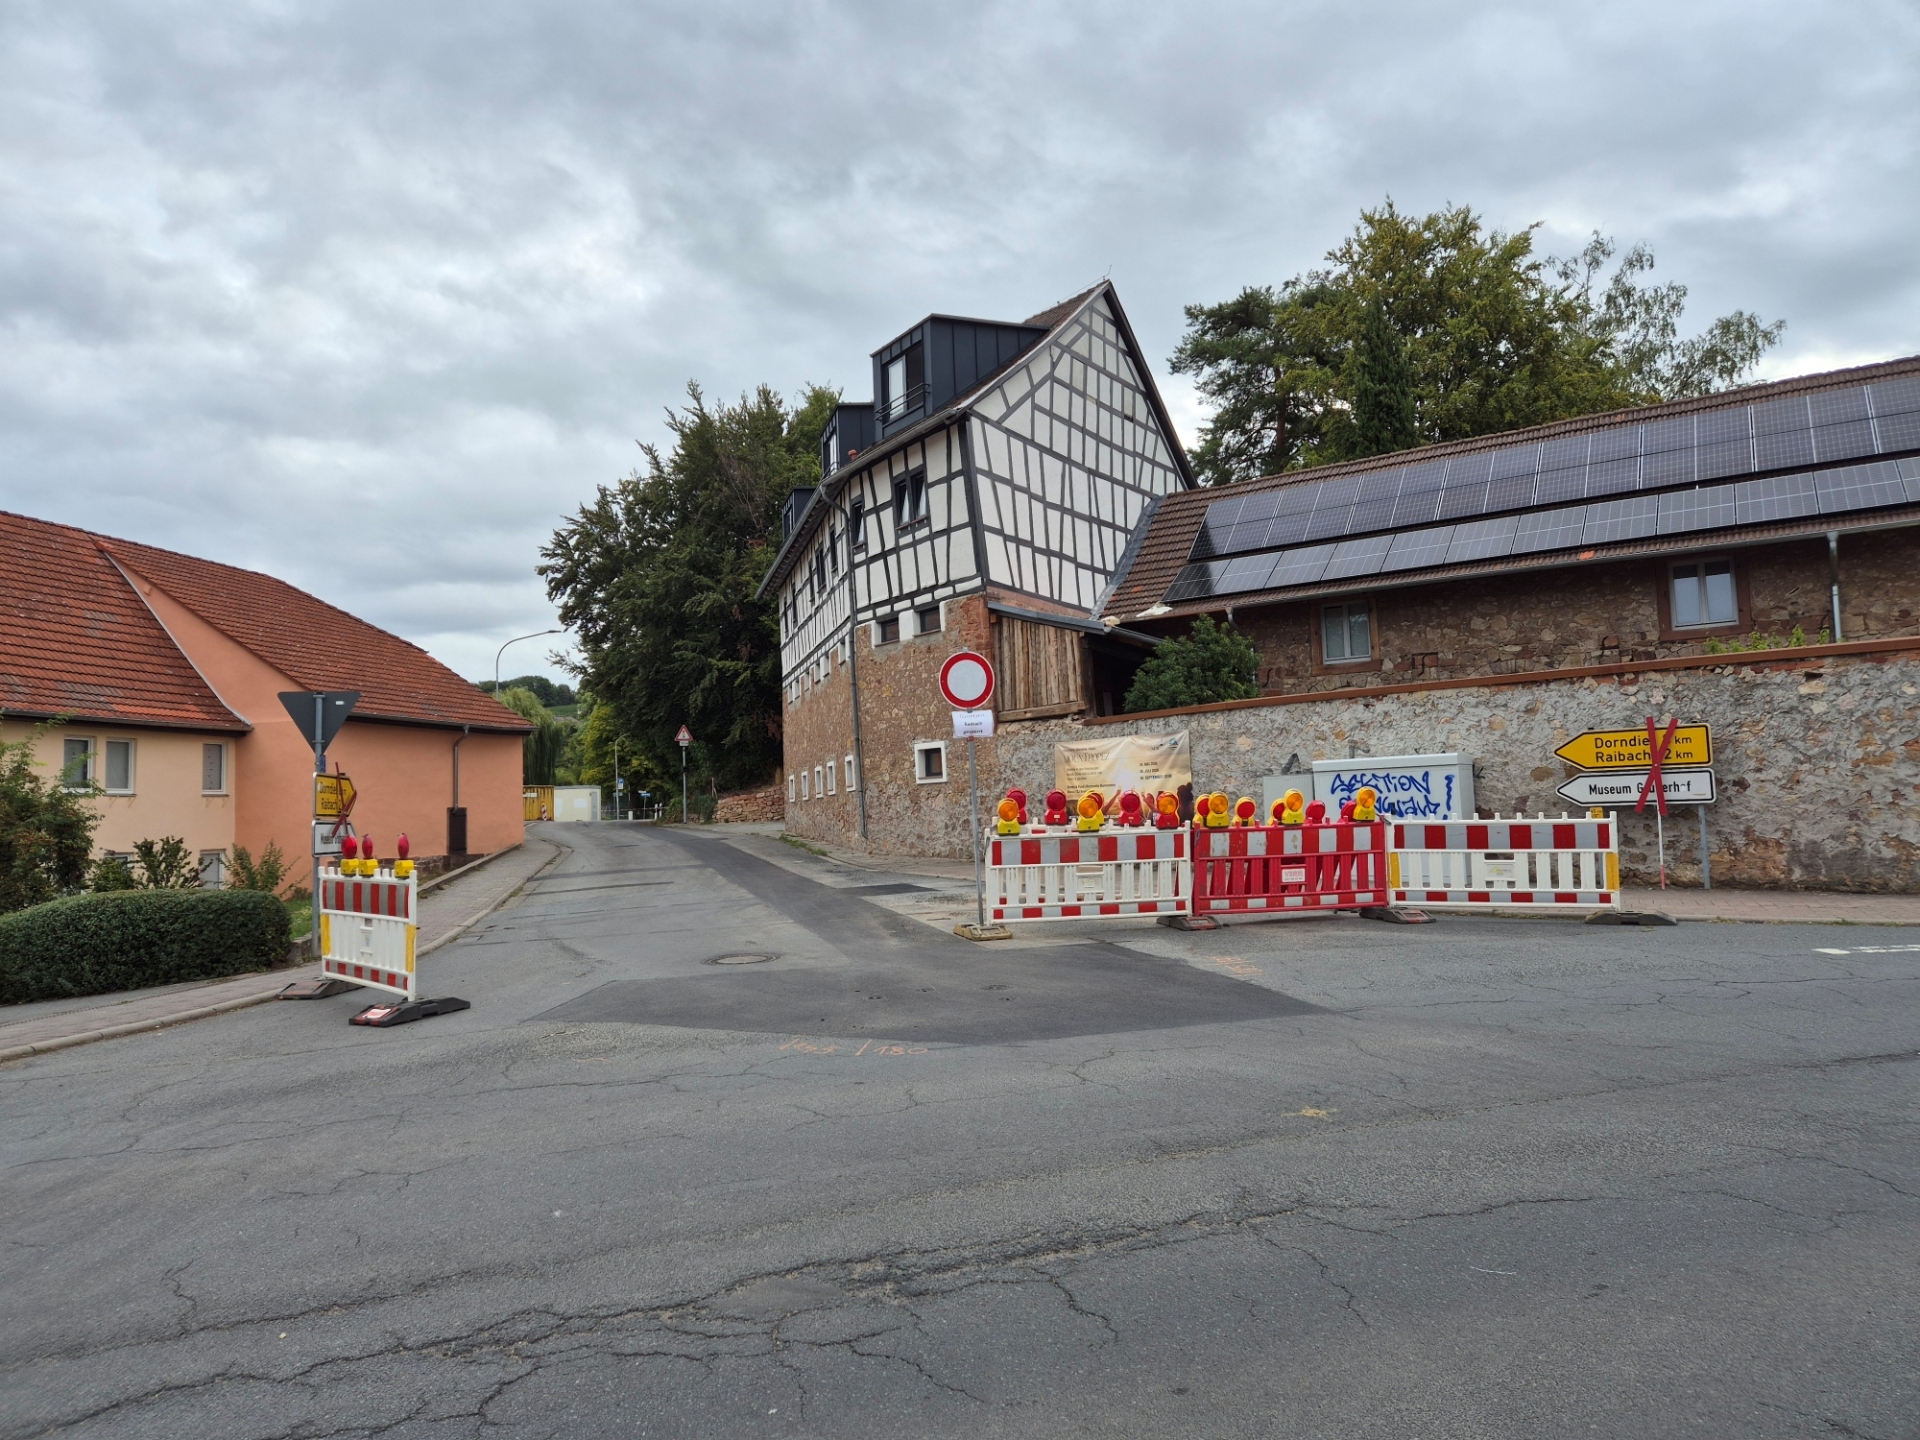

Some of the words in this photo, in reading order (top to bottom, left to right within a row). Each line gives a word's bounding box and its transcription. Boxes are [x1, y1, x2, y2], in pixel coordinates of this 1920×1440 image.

[1594, 735, 1651, 749] Dorndie
[1674, 735, 1692, 745] km
[1596, 750, 1651, 763] Raibach
[1664, 748, 1672, 759] 2
[1675, 750, 1693, 759] km
[1589, 783, 1632, 796] Museum
